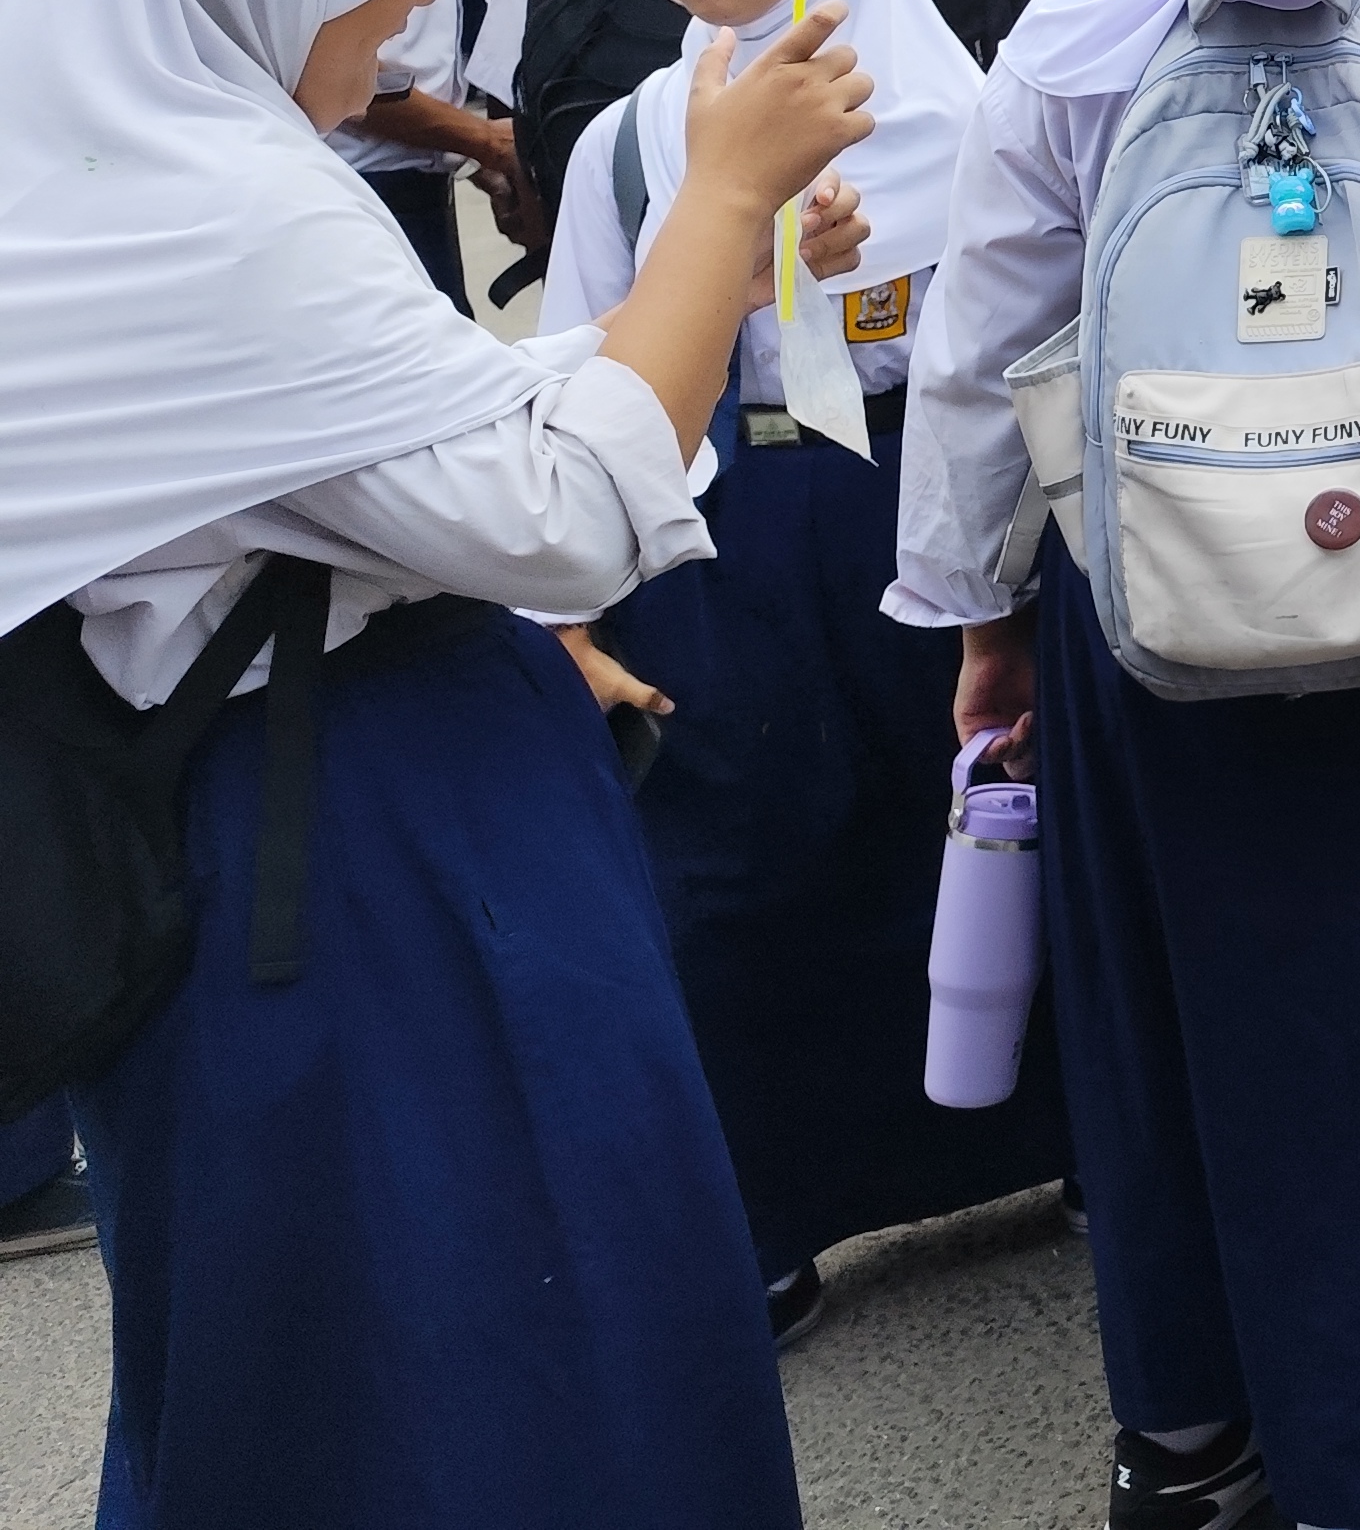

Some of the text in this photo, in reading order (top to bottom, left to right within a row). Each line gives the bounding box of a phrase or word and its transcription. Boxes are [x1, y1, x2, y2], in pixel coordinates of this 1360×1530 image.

[1150, 421, 1213, 444] FUNY
[1243, 428, 1305, 448] FUNY
[1329, 508, 1347, 522] BOY
[1333, 500, 1353, 516] THIS
[1328, 517, 1338, 526] IS
